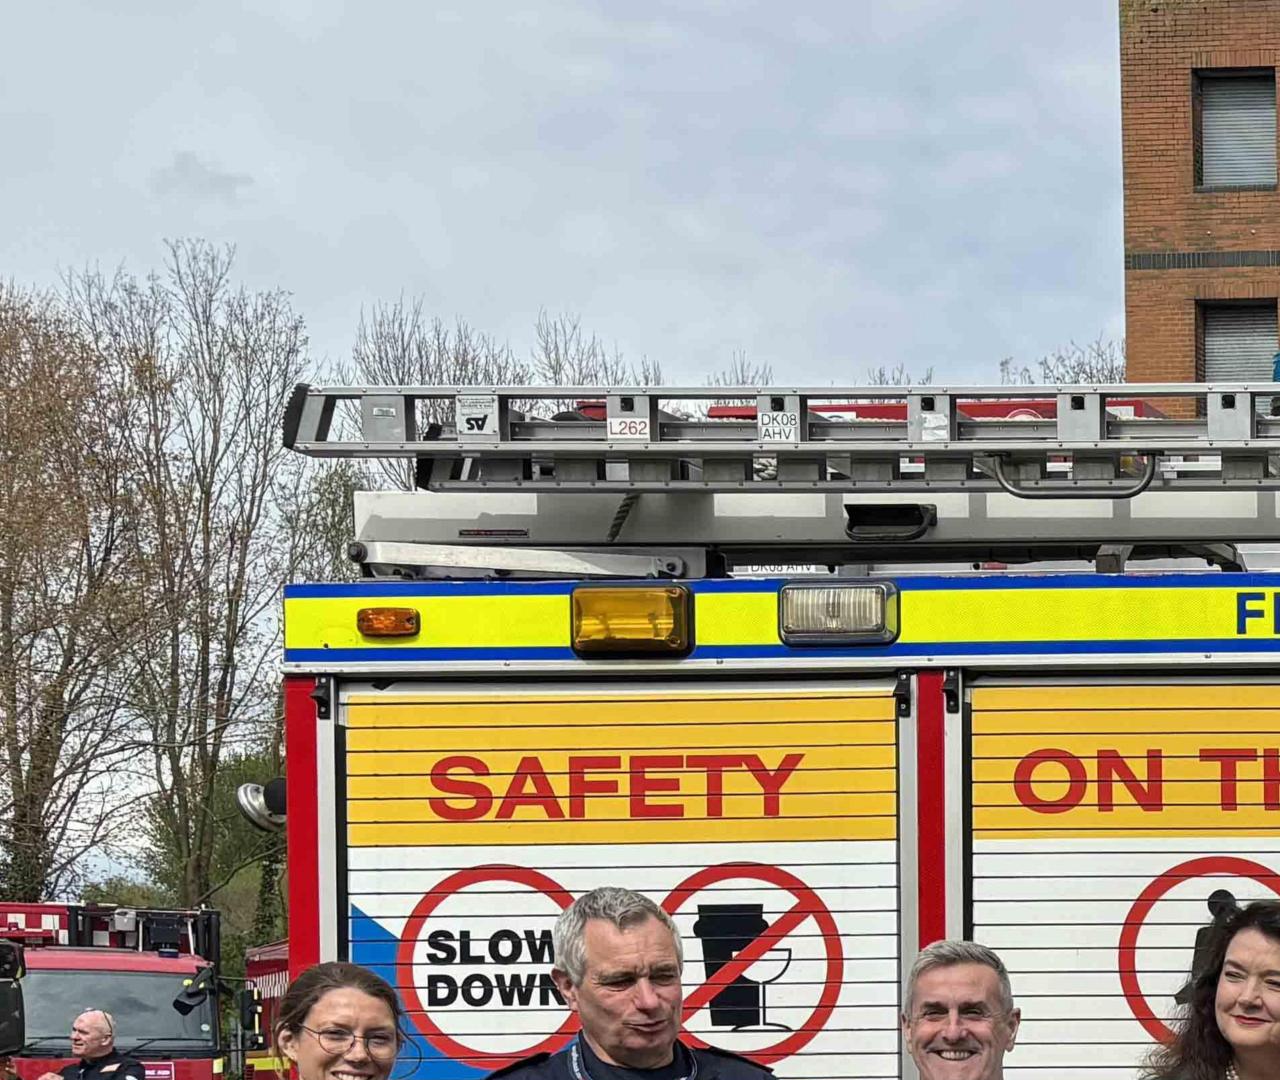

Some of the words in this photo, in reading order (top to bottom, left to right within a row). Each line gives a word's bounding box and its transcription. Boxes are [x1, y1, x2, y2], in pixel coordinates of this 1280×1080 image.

[609, 420, 649, 436] L262
[761, 413, 798, 426] DK08
[762, 428, 793, 440] AHV
[429, 753, 804, 822] SAFETY
[1013, 748, 1163, 814] ON
[426, 929, 554, 965] SLOW
[427, 973, 567, 1007] DOWN
